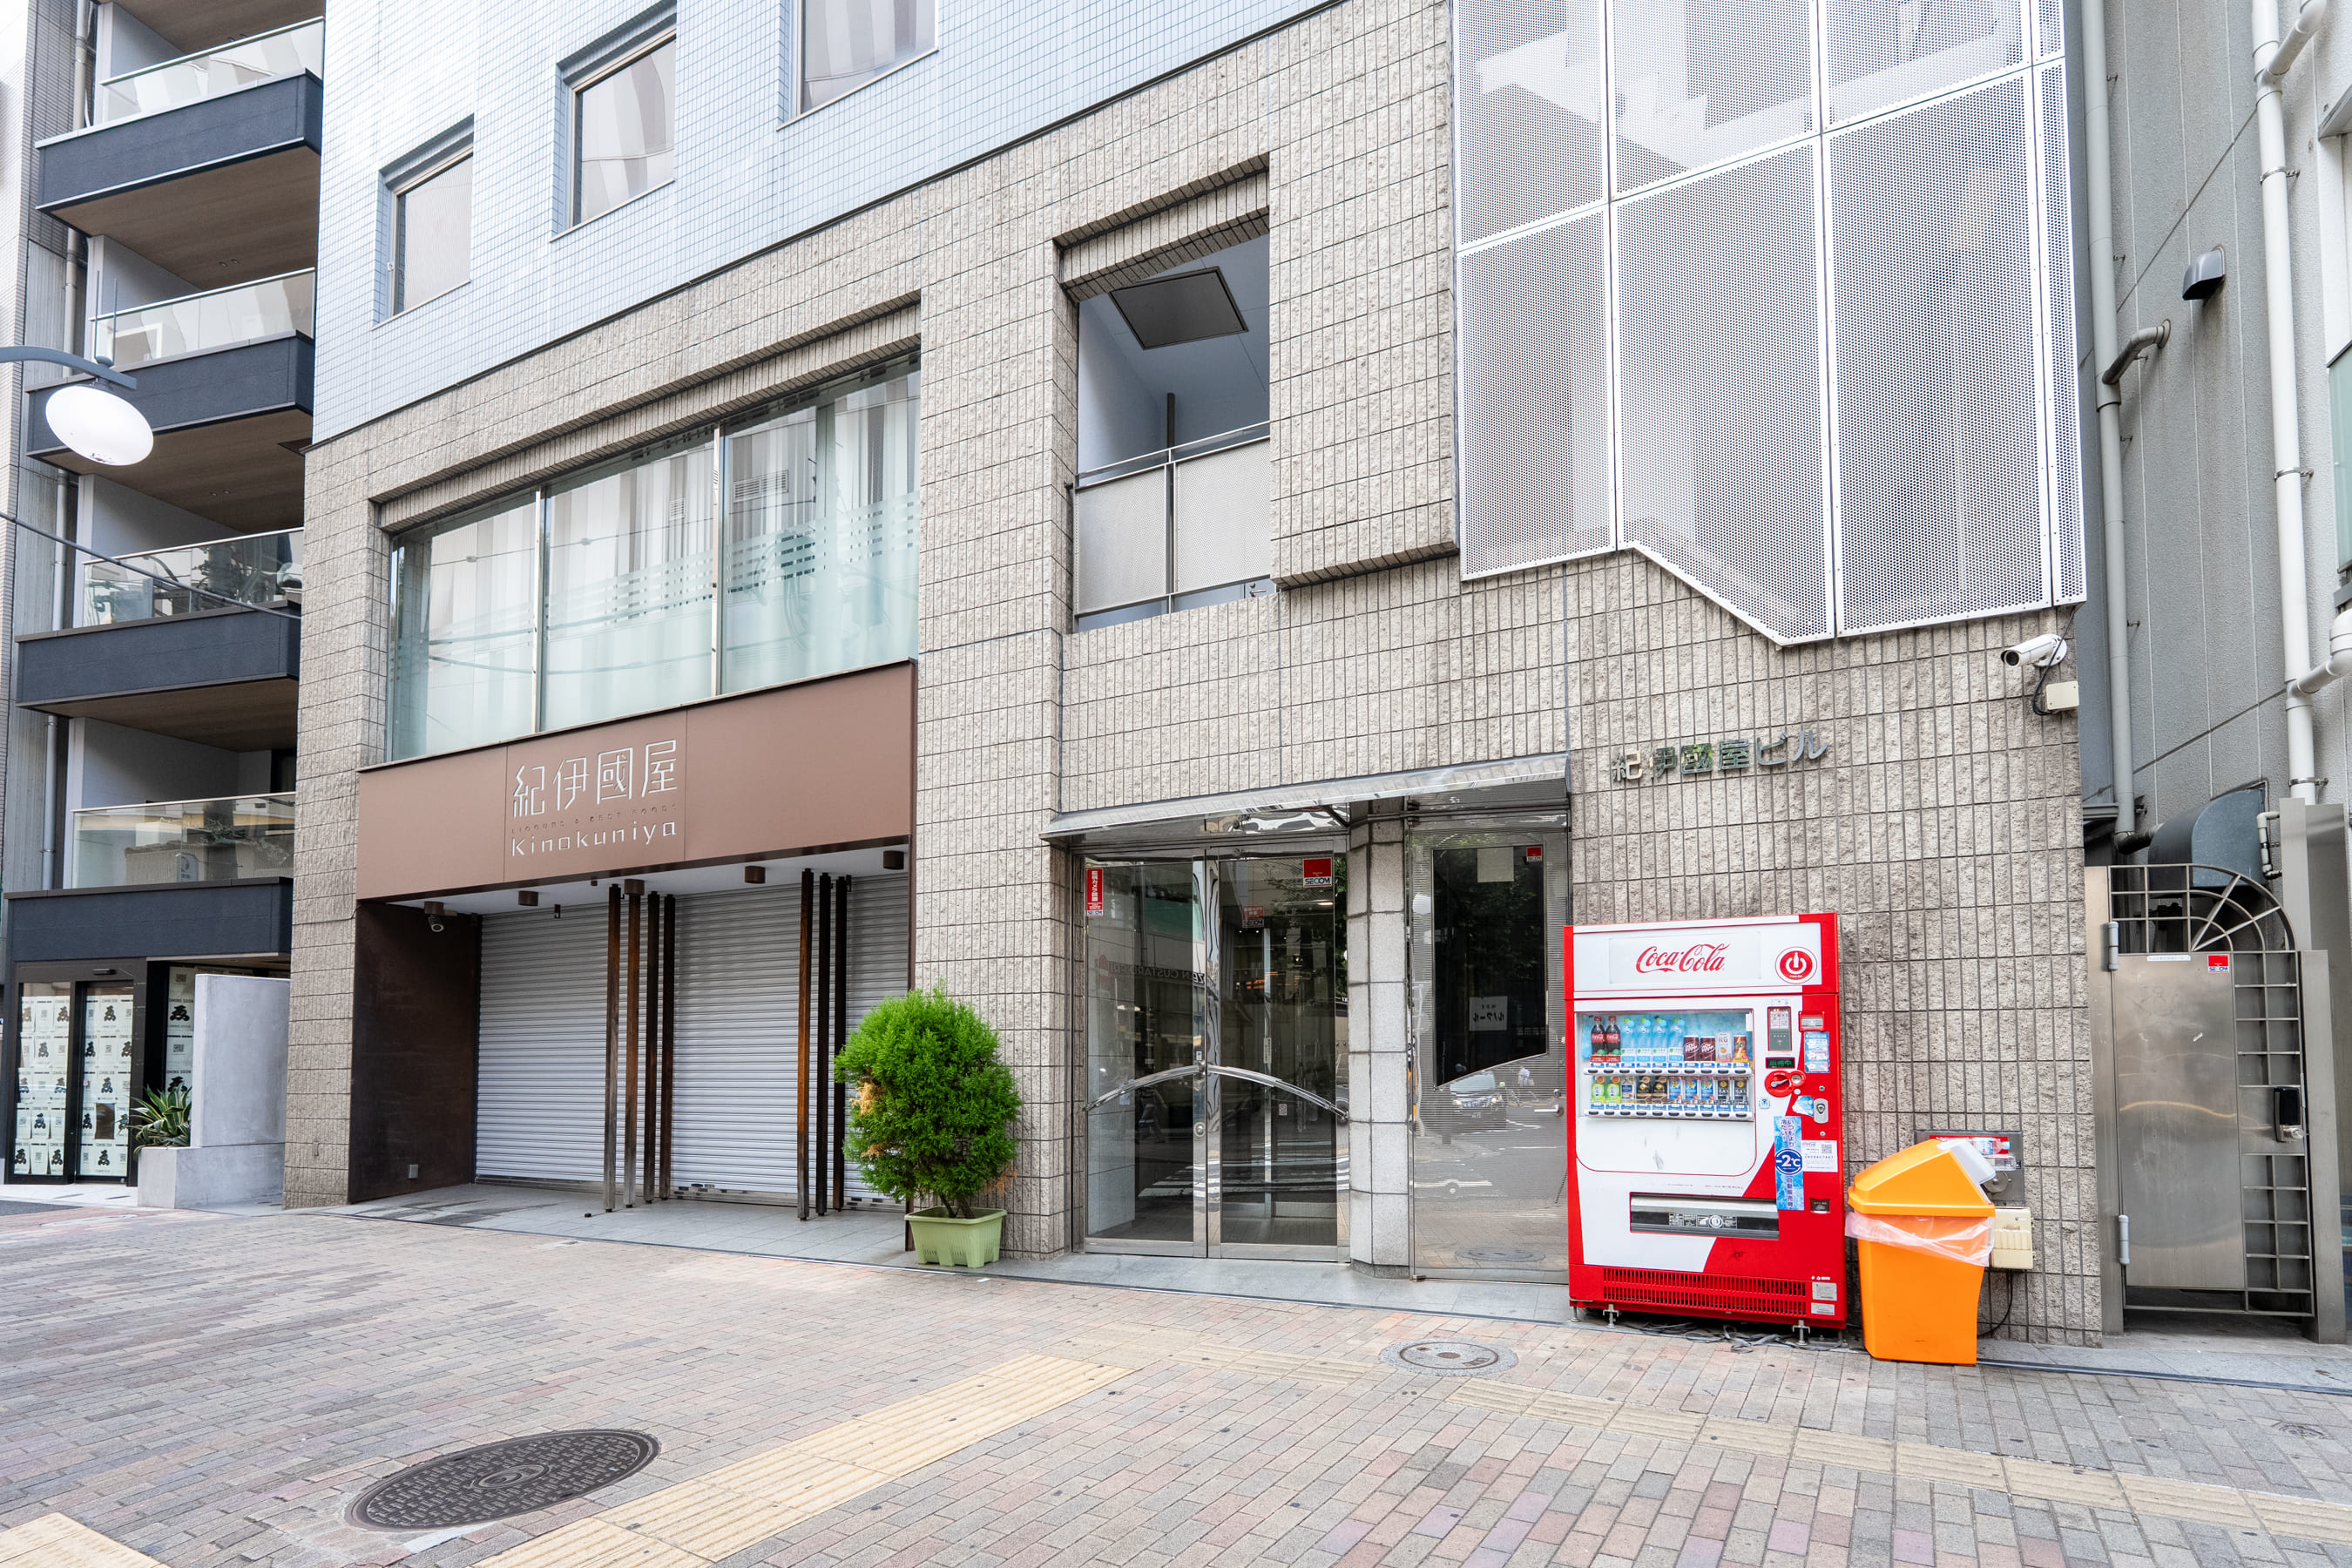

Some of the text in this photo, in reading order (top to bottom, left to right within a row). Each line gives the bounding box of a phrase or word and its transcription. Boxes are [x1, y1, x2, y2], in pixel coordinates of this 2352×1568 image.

[1612, 730, 1829, 781] 紀伊國屋ビル
[513, 739, 677, 818] 紀伊國屋
[512, 821, 677, 857] Kinokuniya
[1636, 943, 1730, 974] Coca-Cola
